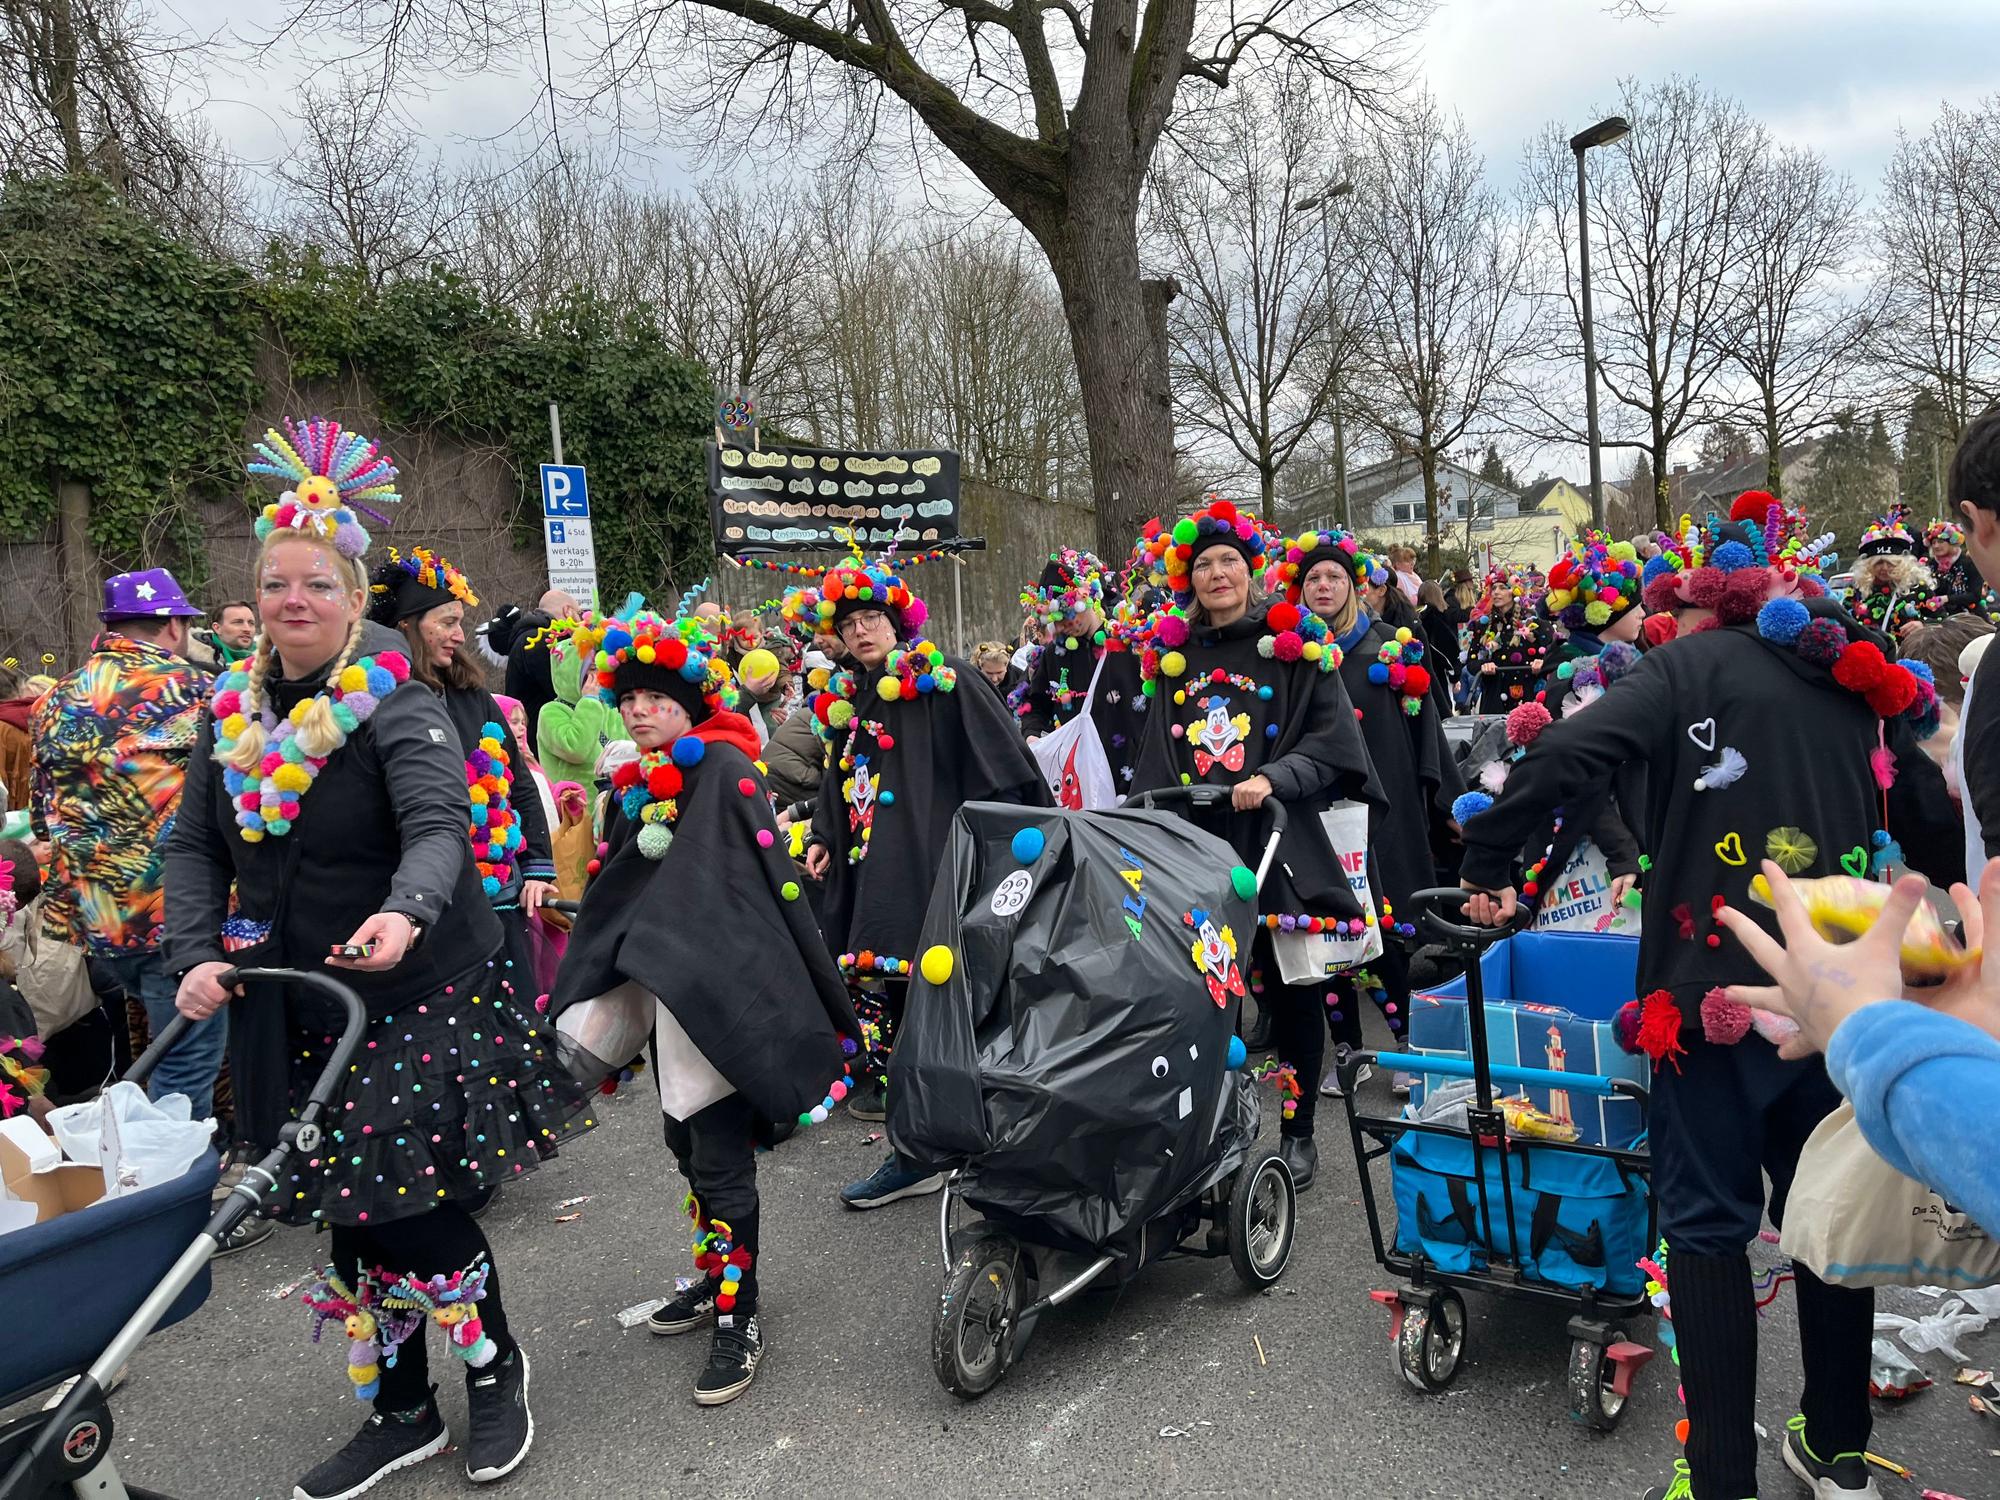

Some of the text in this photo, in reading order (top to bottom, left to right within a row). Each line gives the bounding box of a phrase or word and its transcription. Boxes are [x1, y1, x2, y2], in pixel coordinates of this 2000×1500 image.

[724, 401, 751, 426] 33
[751, 453, 786, 466] Kinder
[821, 457, 839, 467] der
[547, 471, 571, 509] P
[820, 482, 837, 492] dat
[782, 504, 810, 515] durch
[551, 547, 589, 557] werktags
[560, 558, 583, 567] 8-20h
[552, 576, 594, 585] Elektrofahrzeuge
[994, 877, 1029, 908] 33
[1539, 896, 1602, 926] IM BEUTEL!
